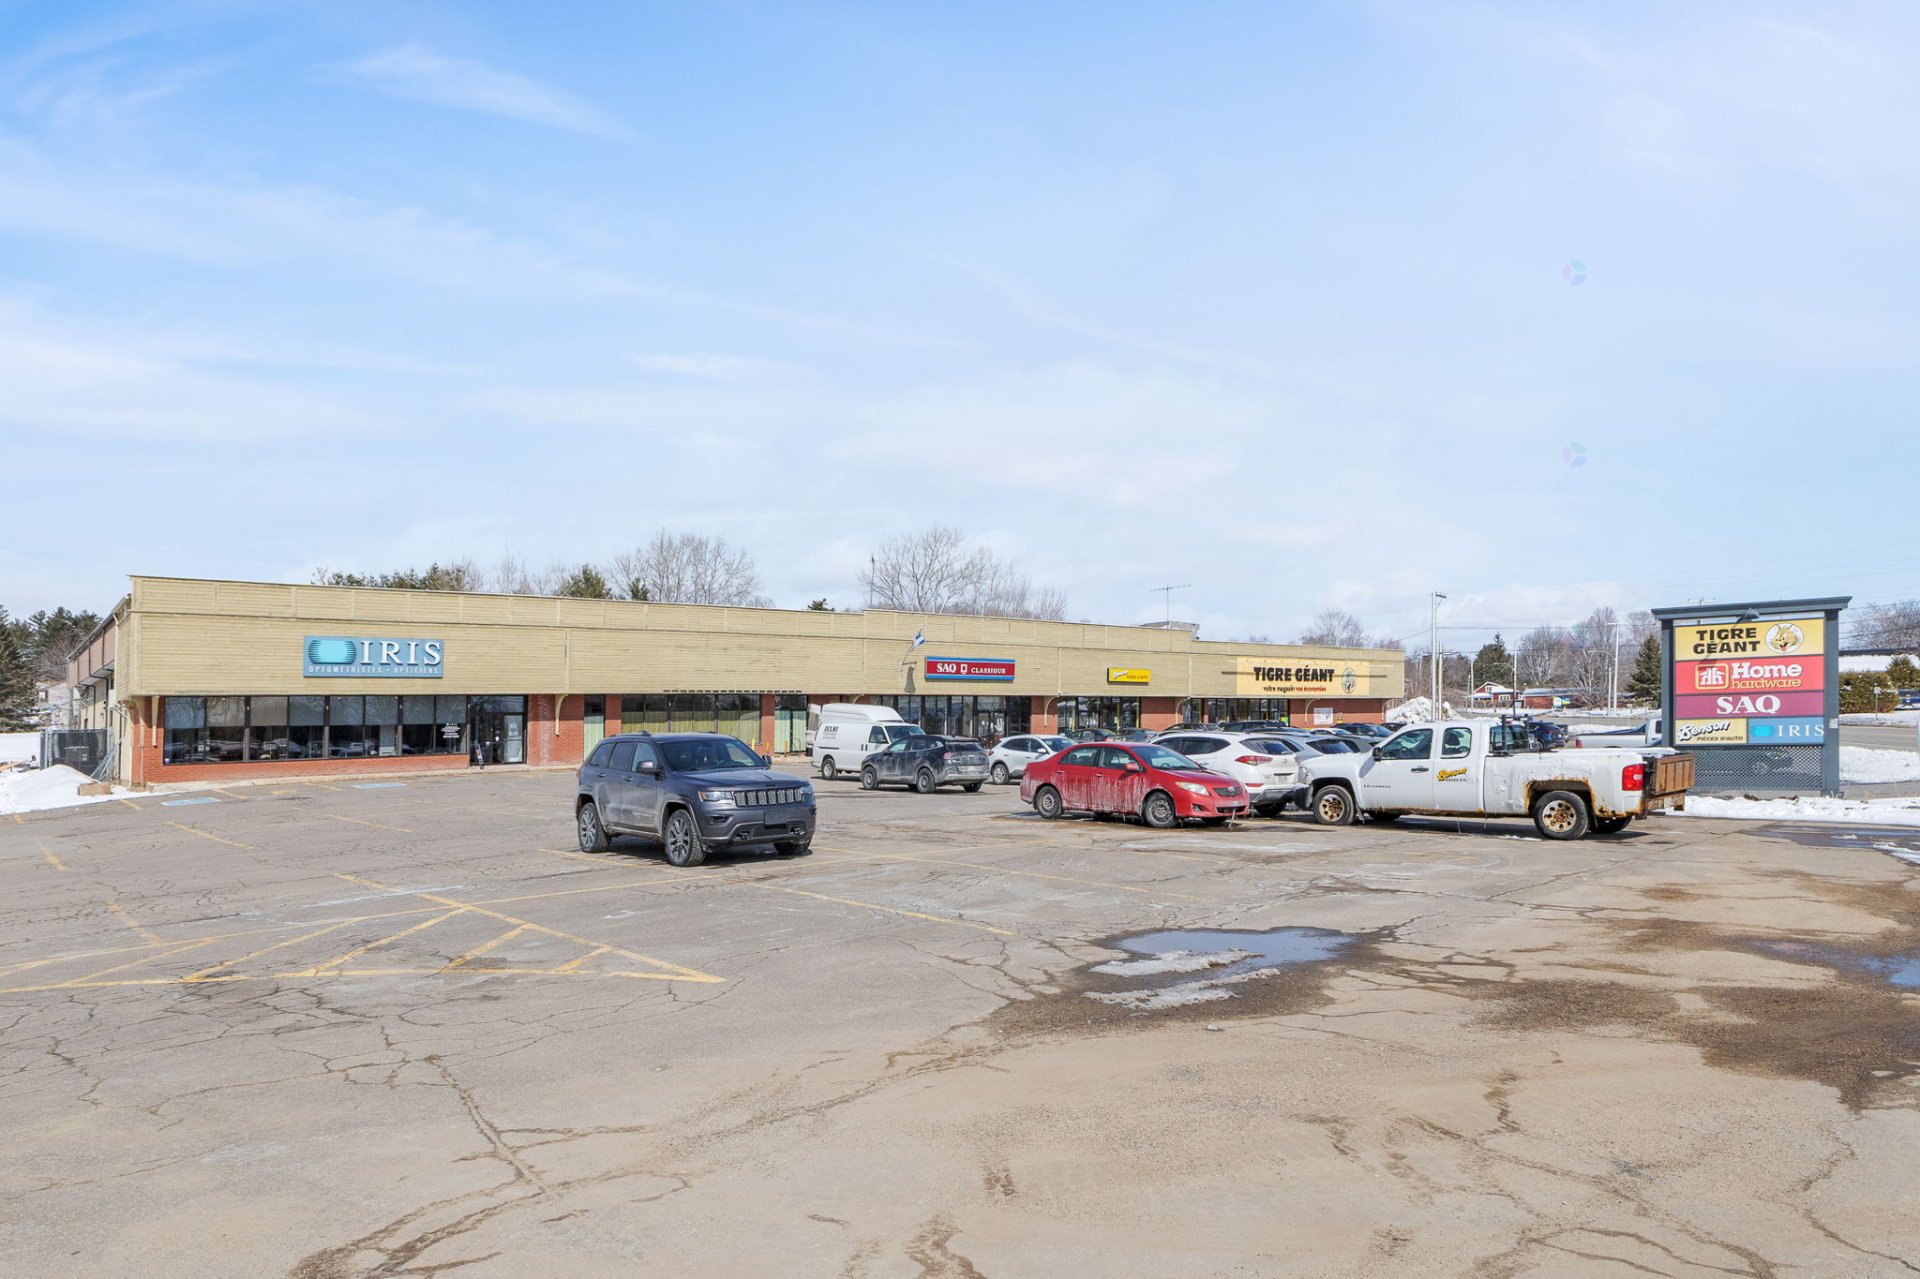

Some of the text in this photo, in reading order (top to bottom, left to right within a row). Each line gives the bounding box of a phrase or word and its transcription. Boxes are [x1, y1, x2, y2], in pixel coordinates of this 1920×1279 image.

[1696, 627, 1757, 641] TIGRE
[360, 640, 441, 665] IRIS
[1692, 640, 1760, 655] GÉANT
[936, 663, 957, 673] SAQ
[1254, 665, 1334, 682] TIGRE GÉANT
[1731, 661, 1803, 678] Home
[1732, 678, 1802, 690] hardware
[1716, 695, 1781, 715] SAQ
[1677, 720, 1731, 741] Benson
[1777, 724, 1824, 737] IRIS
